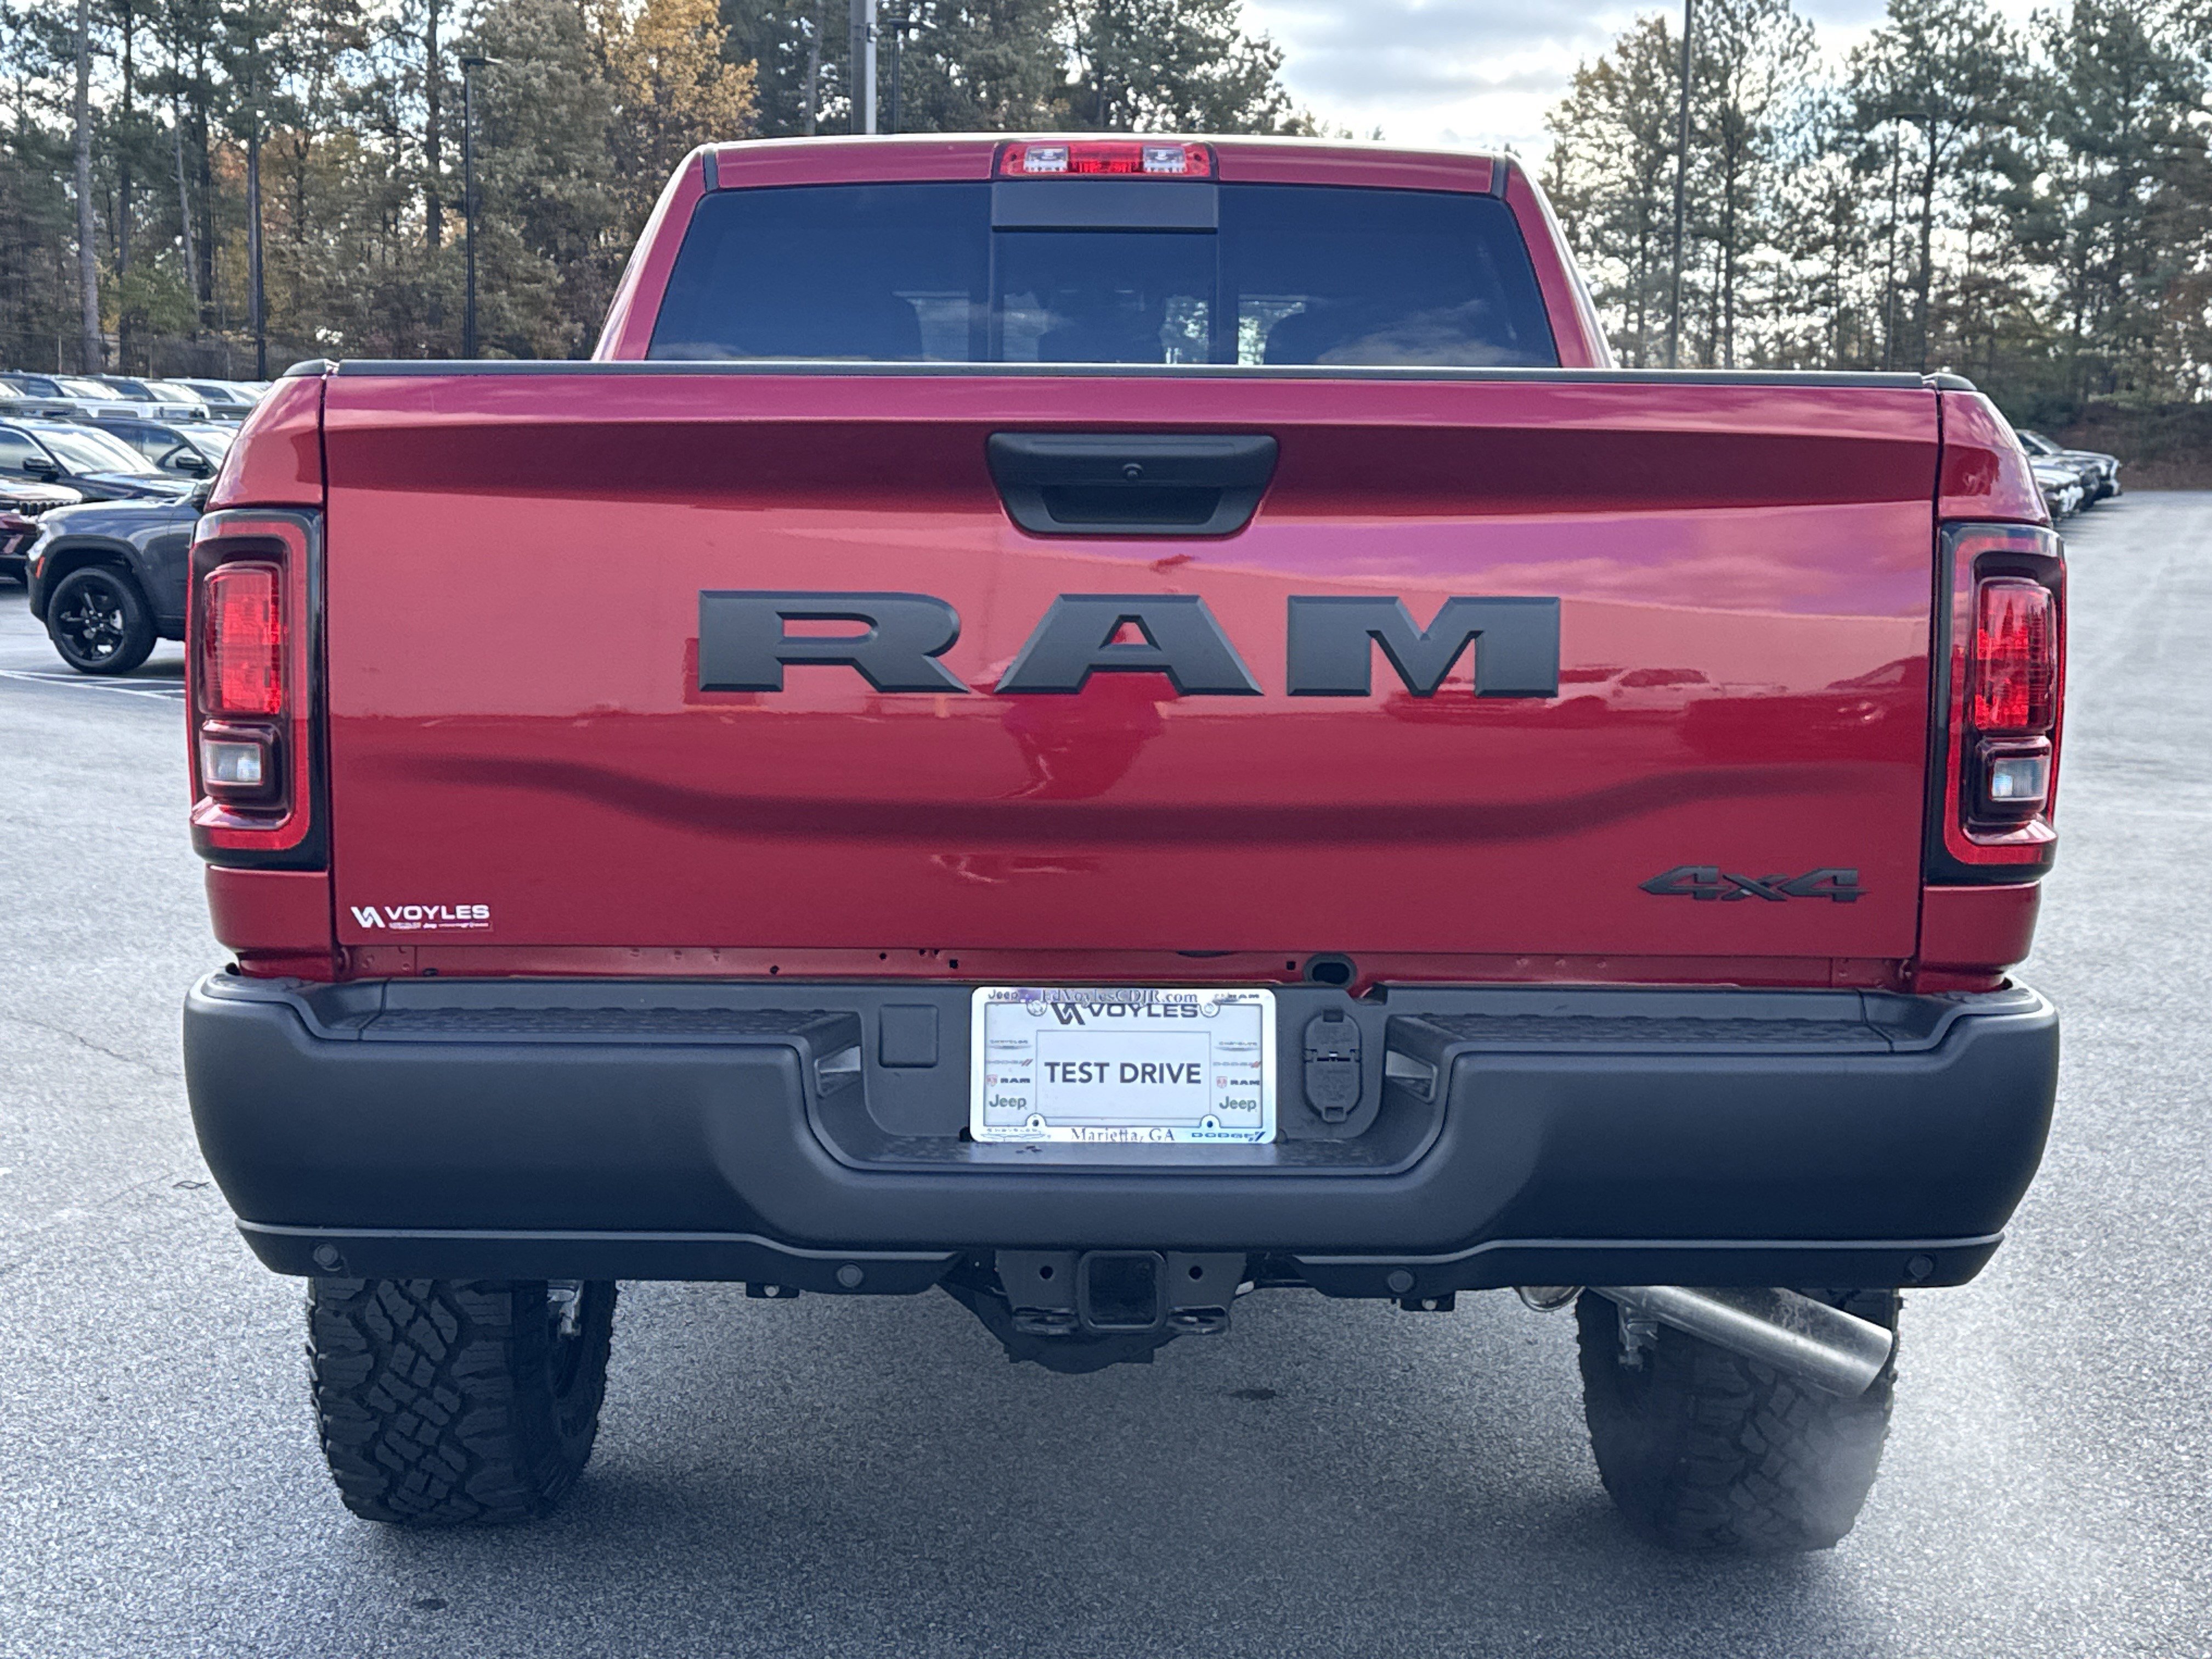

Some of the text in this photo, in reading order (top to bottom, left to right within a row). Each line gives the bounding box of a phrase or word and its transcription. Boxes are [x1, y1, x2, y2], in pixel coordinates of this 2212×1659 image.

[698, 589, 1561, 697] RAM
[384, 905, 490, 920] VOYLES
[988, 989, 1019, 1001] Jeep
[1088, 1003, 1198, 1018] VOYLES
[1044, 1062, 1201, 1084] TEST DRIVE
[989, 1094, 1027, 1110] Jeep
[1219, 1096, 1257, 1112] Jeep
[1149, 1128, 1175, 1141] GA
